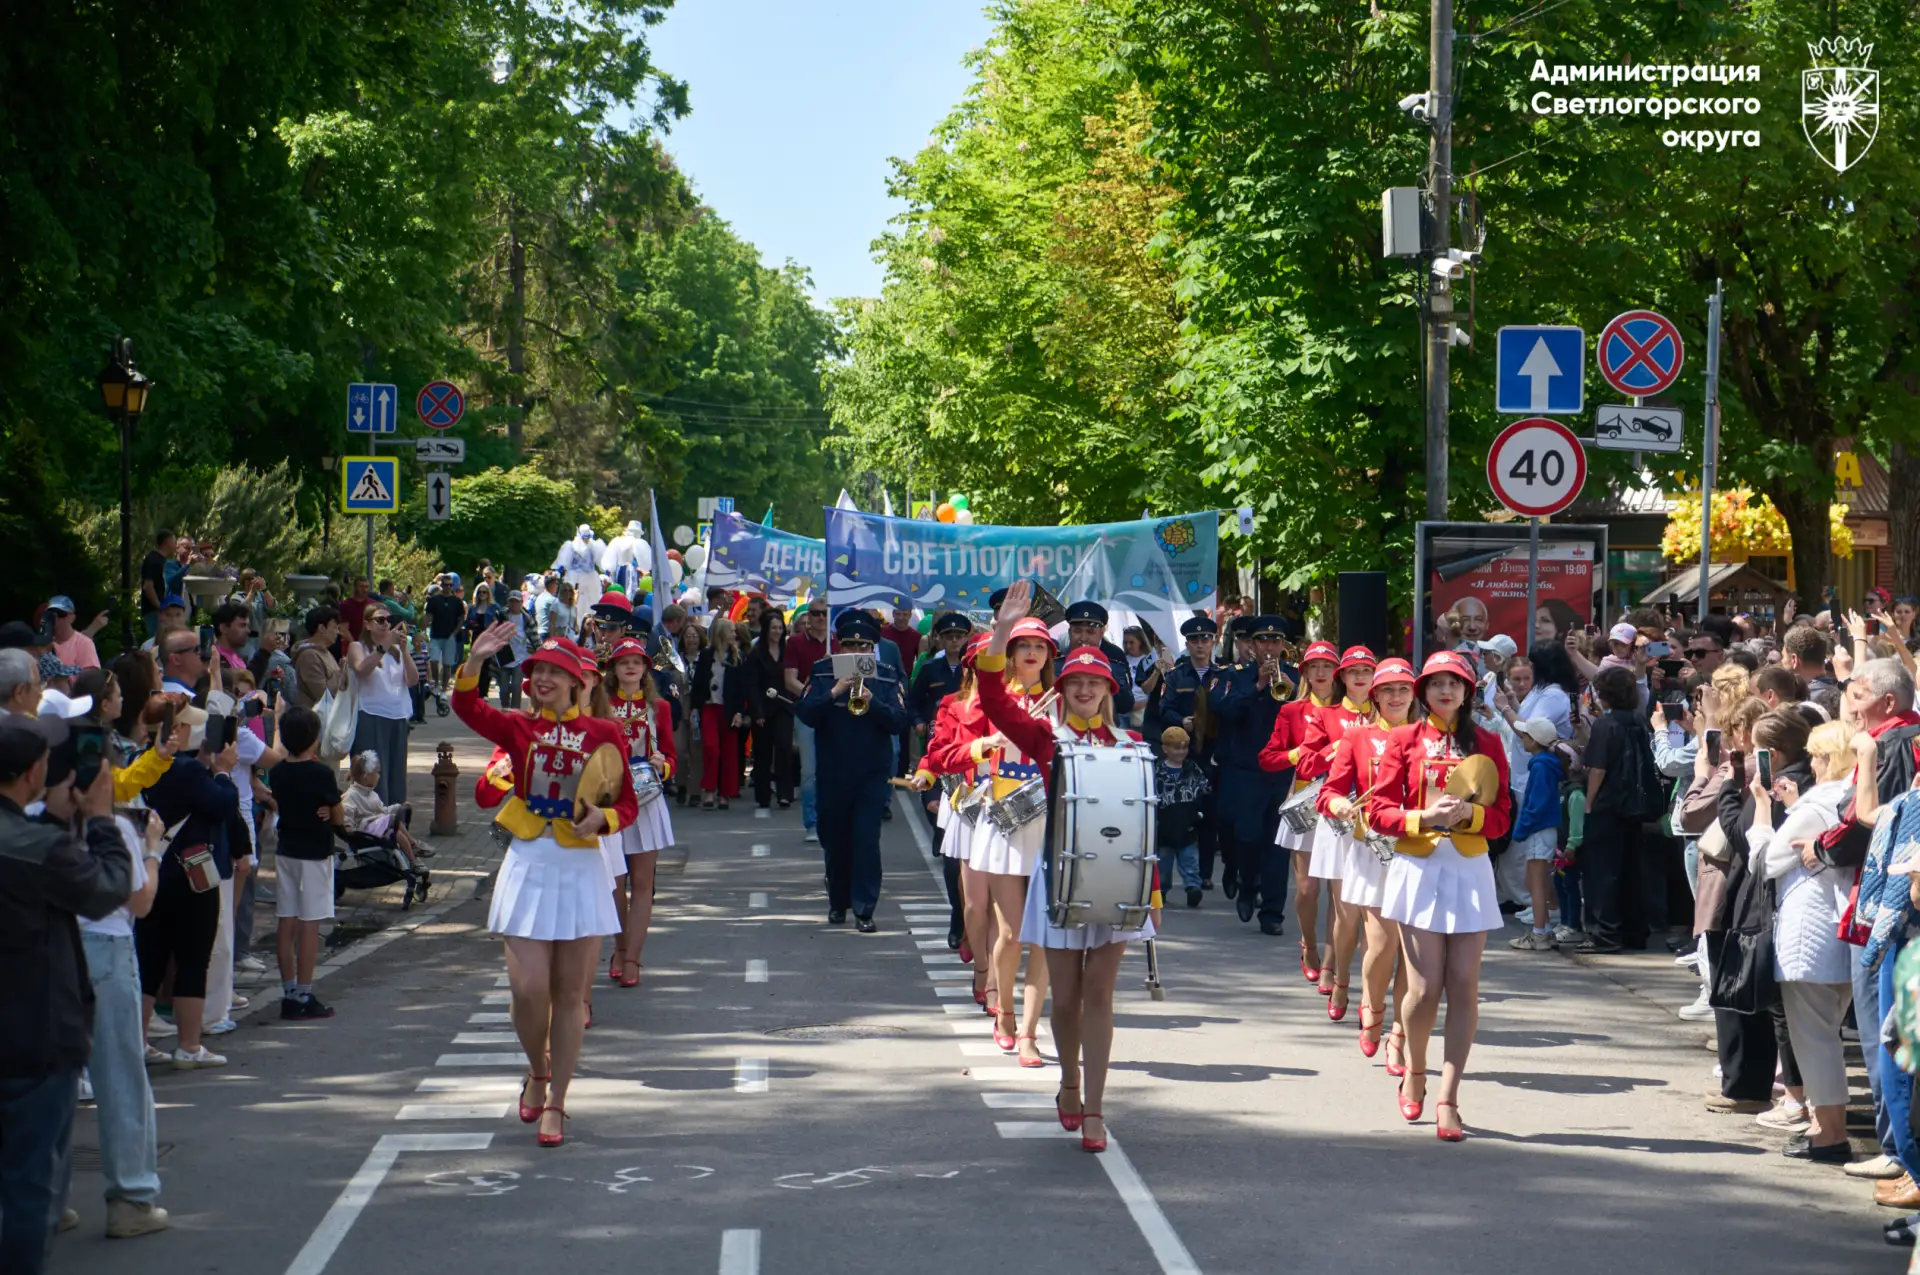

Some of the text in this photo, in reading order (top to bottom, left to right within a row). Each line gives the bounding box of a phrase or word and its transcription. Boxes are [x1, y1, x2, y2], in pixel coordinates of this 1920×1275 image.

[1509, 449, 1565, 487] 40
[760, 541, 825, 574] ДЕНЬ
[883, 541, 1094, 577] СВЕТЛОГОРСК
[1565, 564, 1587, 575] 19:00
[1486, 580, 1523, 589] люблю
